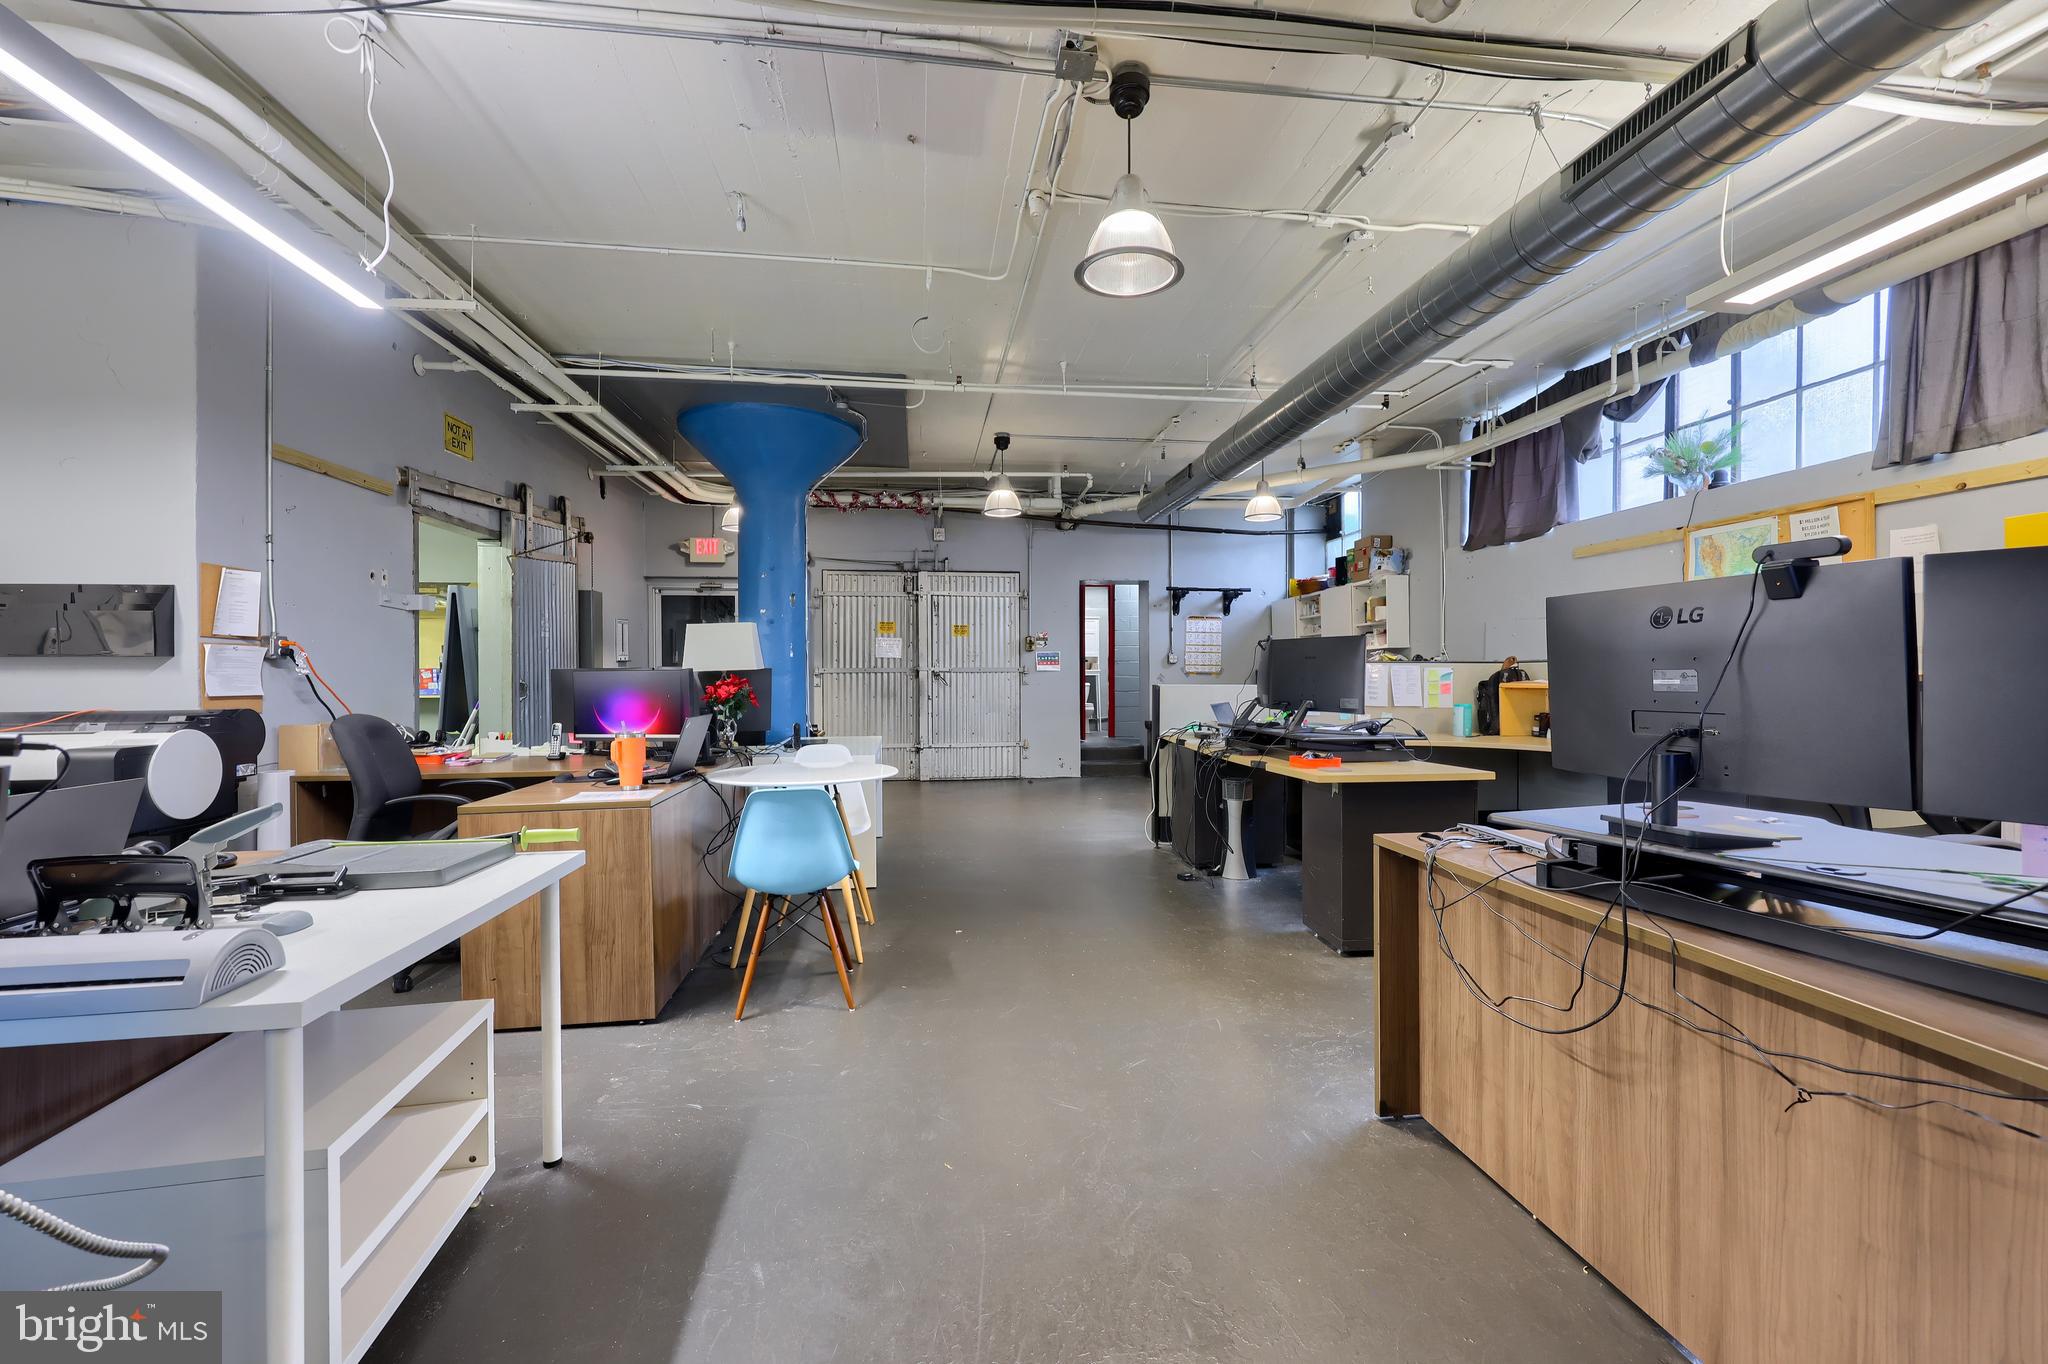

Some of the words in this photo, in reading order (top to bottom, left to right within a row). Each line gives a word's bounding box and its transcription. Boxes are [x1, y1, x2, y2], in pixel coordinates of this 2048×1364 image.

[447, 421, 461, 436] NOT
[462, 428, 471, 441] AN
[451, 437, 467, 452] EXIT
[695, 538, 720, 555] EXIT
[1677, 606, 1704, 624] LG
